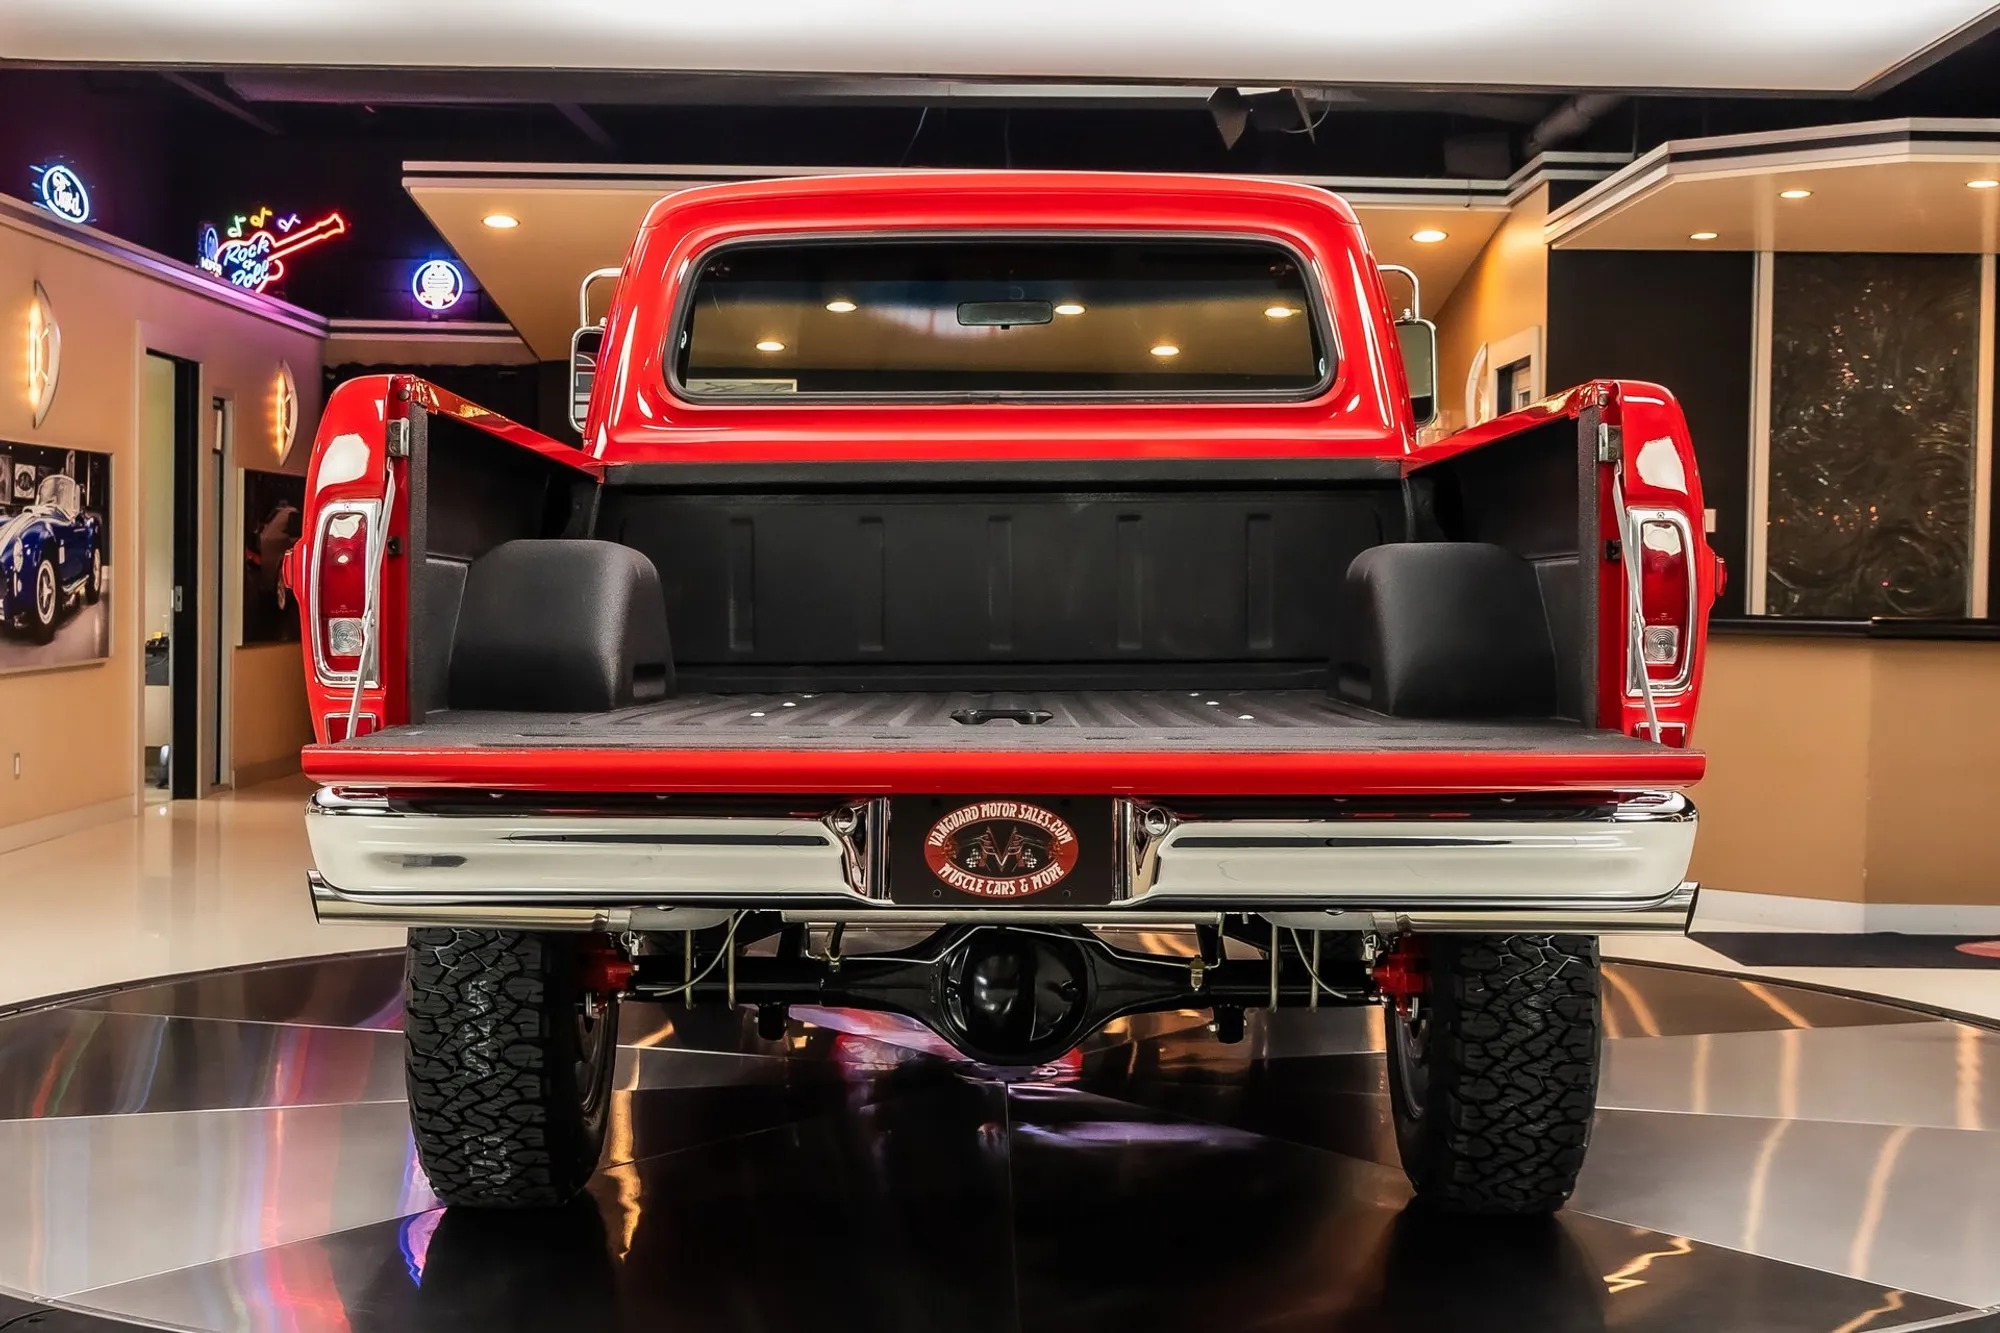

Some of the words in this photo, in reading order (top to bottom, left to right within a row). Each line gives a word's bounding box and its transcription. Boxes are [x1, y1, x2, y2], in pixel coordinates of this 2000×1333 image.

[223, 235, 269, 266] Rock
[928, 806, 980, 847] VANGUARD
[980, 803, 1017, 818] MOTOR
[1018, 804, 1074, 844] SALES.COM
[938, 863, 985, 893] MUSCLE
[986, 880, 1015, 895] CARS
[1019, 879, 1029, 893] &
[1030, 862, 1065, 890] MORE
